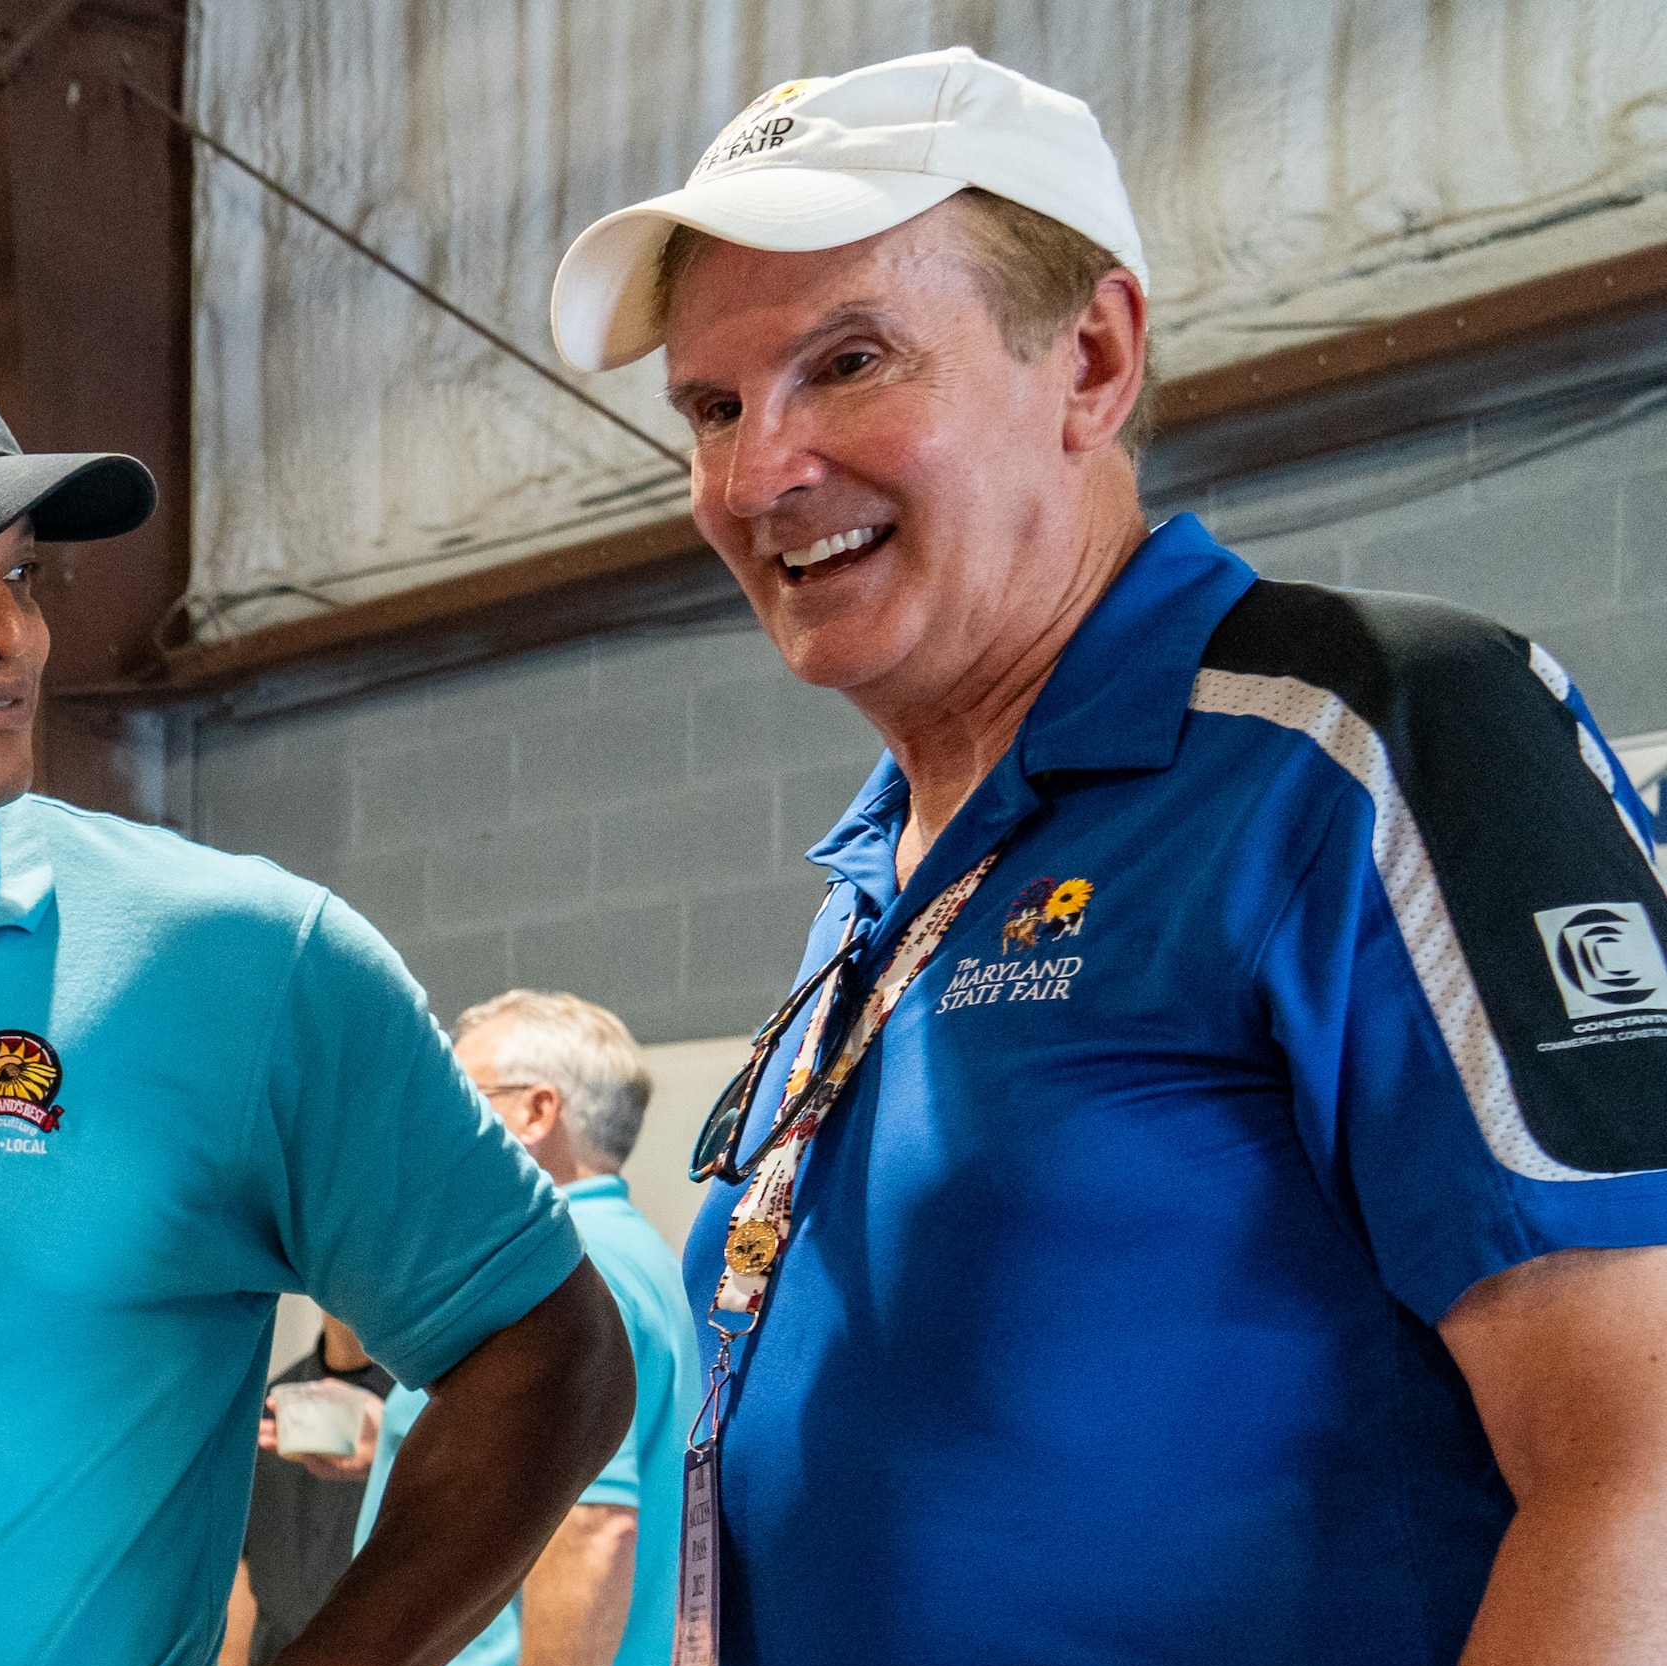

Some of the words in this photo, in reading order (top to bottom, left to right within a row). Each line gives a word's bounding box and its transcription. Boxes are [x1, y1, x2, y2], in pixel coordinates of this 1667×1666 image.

[946, 956, 1083, 993] MARYLAND
[957, 957, 980, 972] The
[935, 983, 1004, 1014] STATE
[1008, 979, 1071, 1001] FAIR
[22, 1103, 47, 1124] BEST
